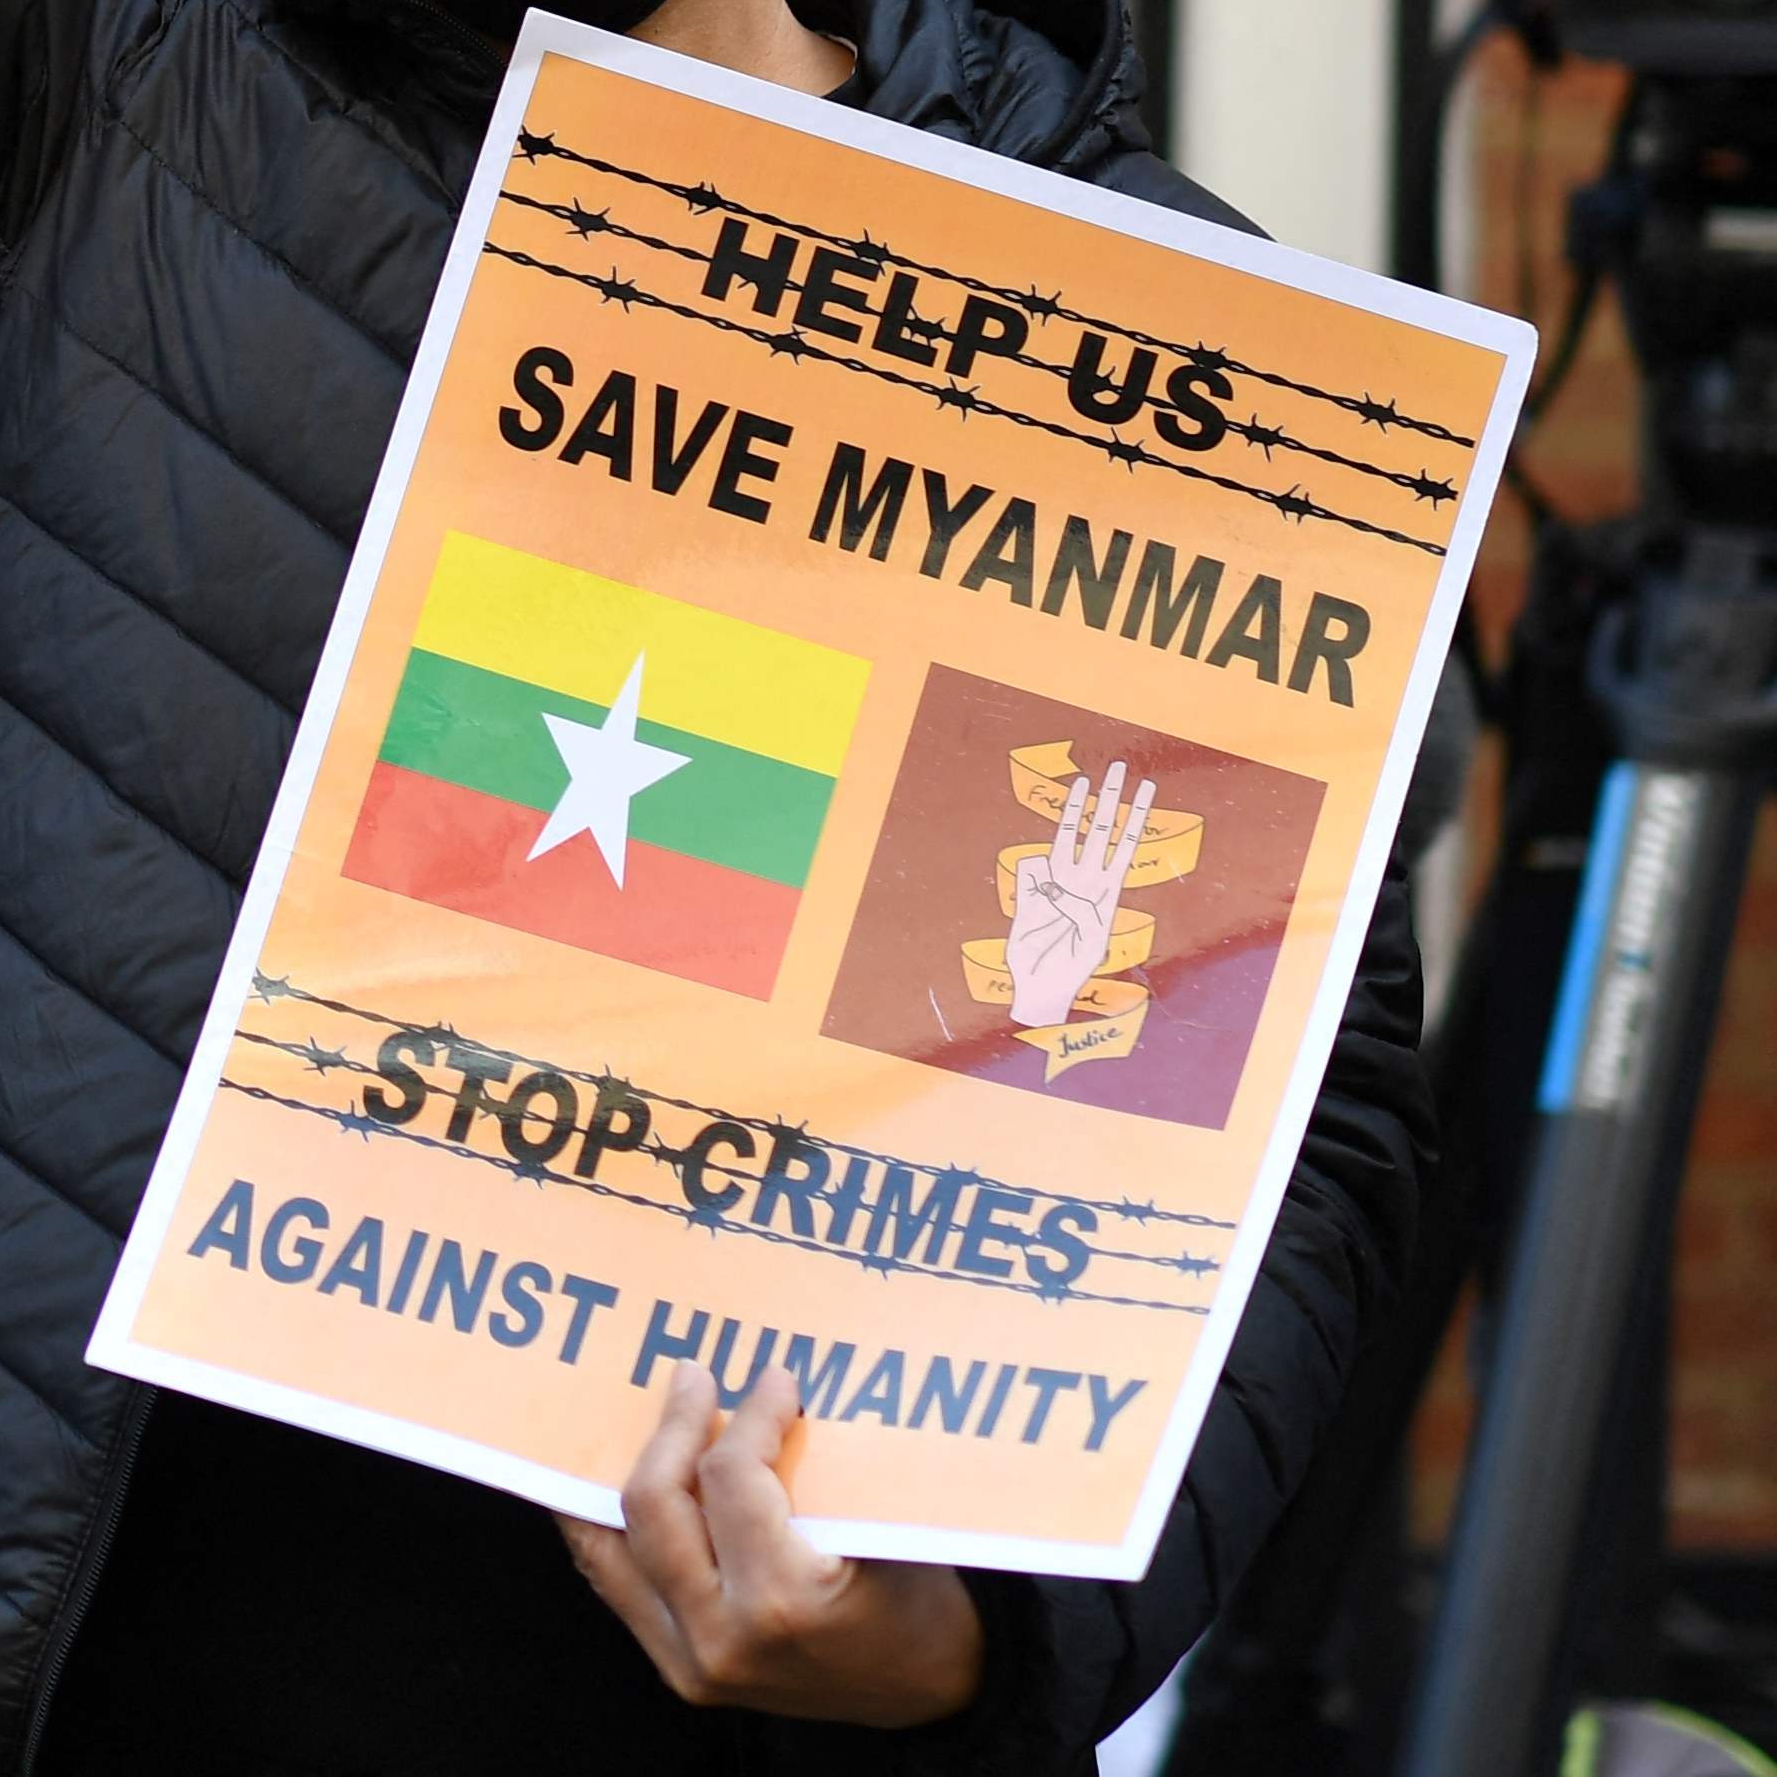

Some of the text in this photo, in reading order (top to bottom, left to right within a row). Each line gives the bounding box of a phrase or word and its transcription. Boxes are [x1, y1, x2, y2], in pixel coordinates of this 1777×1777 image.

[701, 217, 1234, 451] HELP US
[498, 345, 1373, 708] SAVE MYANMAR
[362, 1029, 1099, 1288] STOP CRIMES
[1058, 1027, 1122, 1058] Justice
[186, 1178, 1148, 1454] AGAINST HUMANITY
